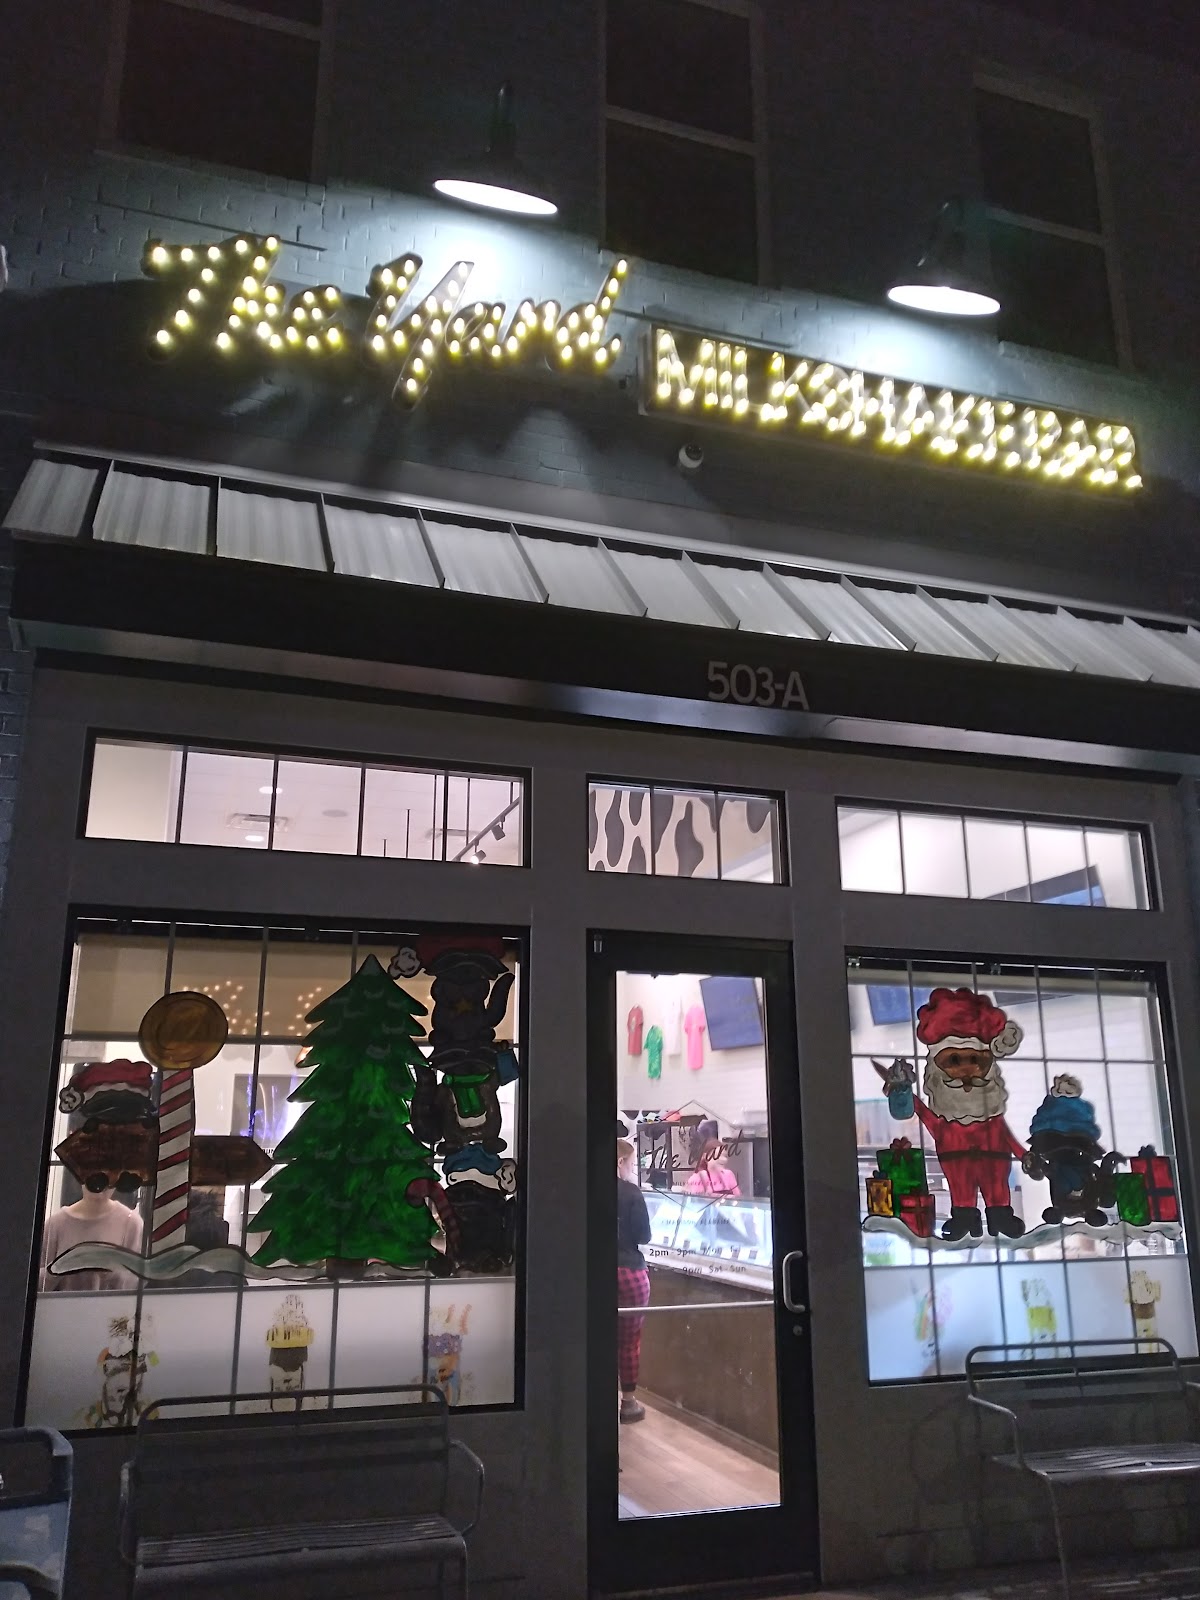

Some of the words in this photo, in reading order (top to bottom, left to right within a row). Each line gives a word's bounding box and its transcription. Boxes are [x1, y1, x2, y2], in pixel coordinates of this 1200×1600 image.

[141, 234, 342, 362] The
[363, 253, 622, 410] Yard
[656, 328, 1020, 468] MILKSHAKE
[1022, 407, 1143, 488] BAR
[707, 660, 810, 711] 503-A
[644, 1146, 681, 1174] The
[649, 1248, 669, 1257] 2pm
[676, 1247, 696, 1258] 9pm
[708, 1264, 722, 1273] Sat
[730, 1264, 747, 1273] Sun
